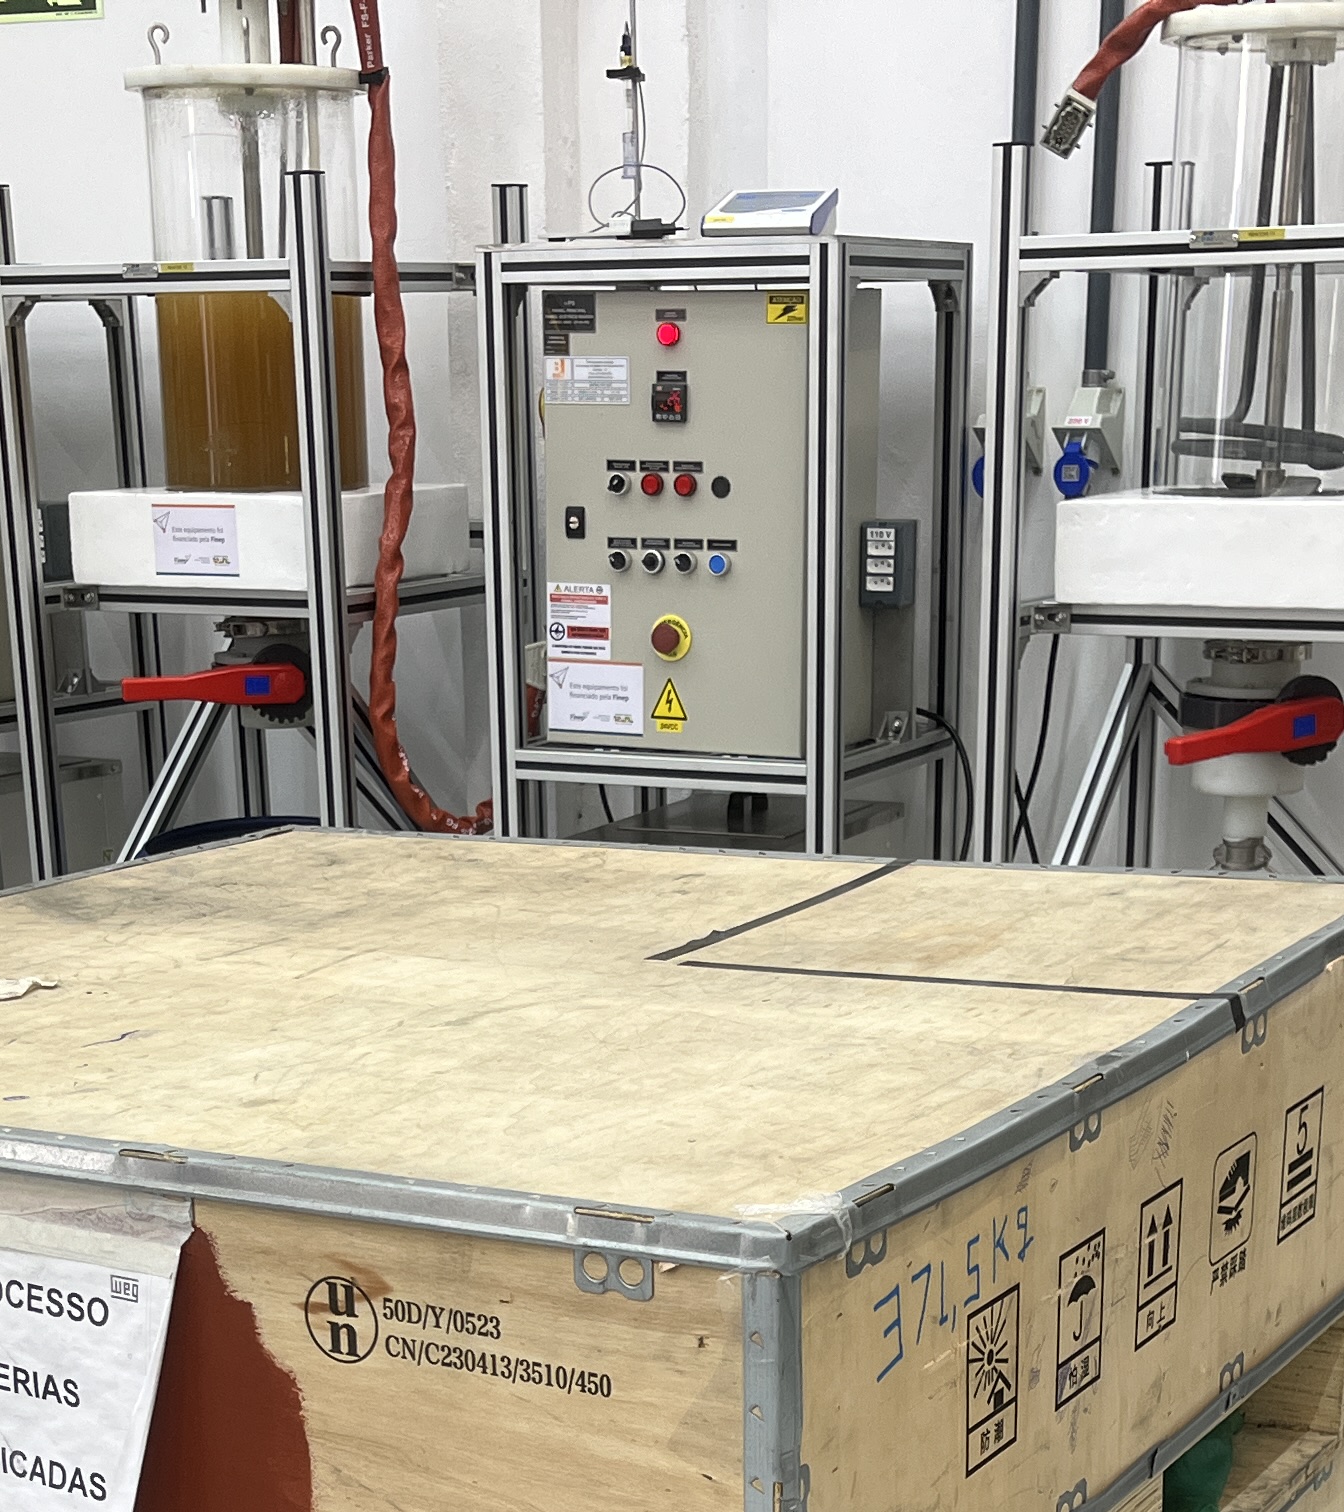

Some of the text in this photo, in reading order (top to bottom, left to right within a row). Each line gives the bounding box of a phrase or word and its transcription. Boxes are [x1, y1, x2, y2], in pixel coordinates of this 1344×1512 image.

[869, 530, 892, 539] 110 V
[564, 585, 594, 594] ALERTA
[1296, 1103, 1309, 1156] 5
[382, 1297, 502, 1340] 50D/Y/0523
[1146, 1300, 1166, 1333] 向上
[385, 1334, 612, 1398] CN/C230413/3510/450
